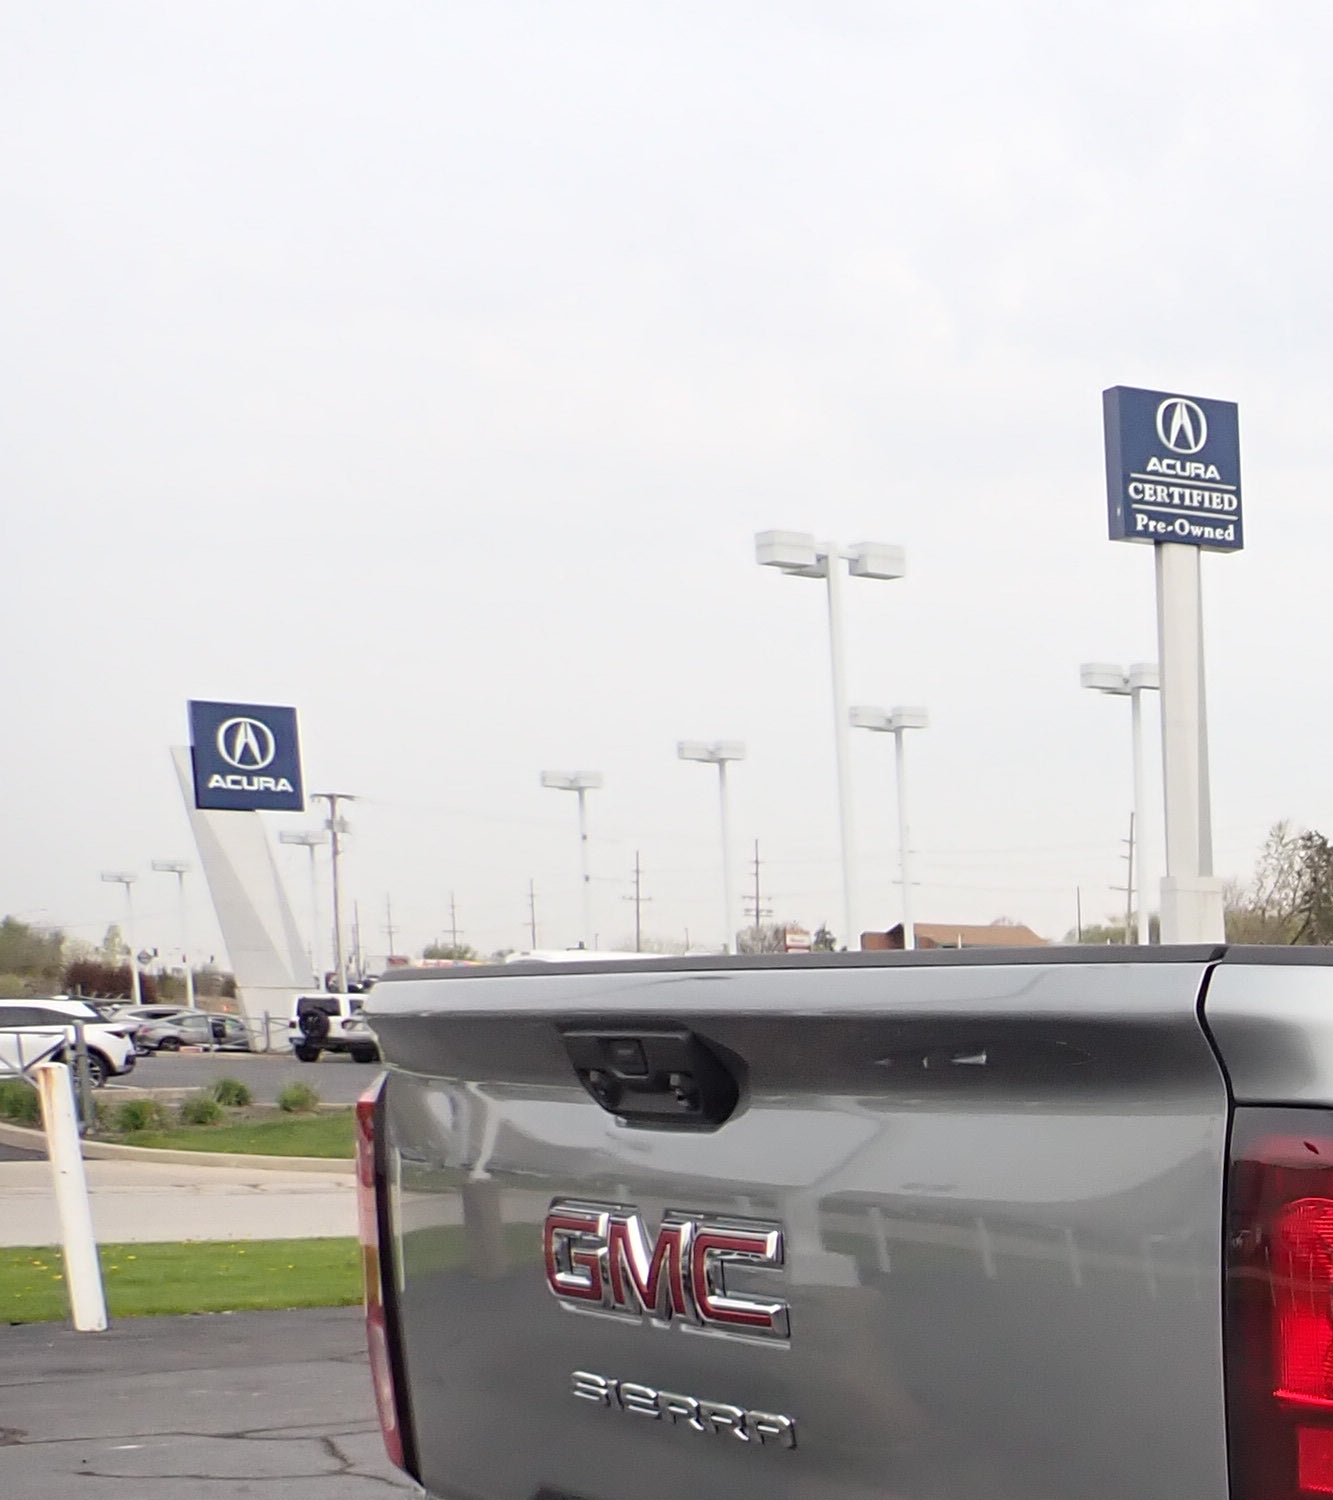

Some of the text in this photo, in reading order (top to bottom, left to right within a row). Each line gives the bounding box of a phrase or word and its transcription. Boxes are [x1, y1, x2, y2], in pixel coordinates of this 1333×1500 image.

[1146, 456, 1221, 480] ACURA
[1128, 482, 1238, 512] CERTIFIED
[1135, 514, 1235, 541] Pre-Owned
[207, 774, 294, 793] ACURA
[543, 1198, 791, 1340] GMC
[571, 1370, 798, 1450] SIERRA
